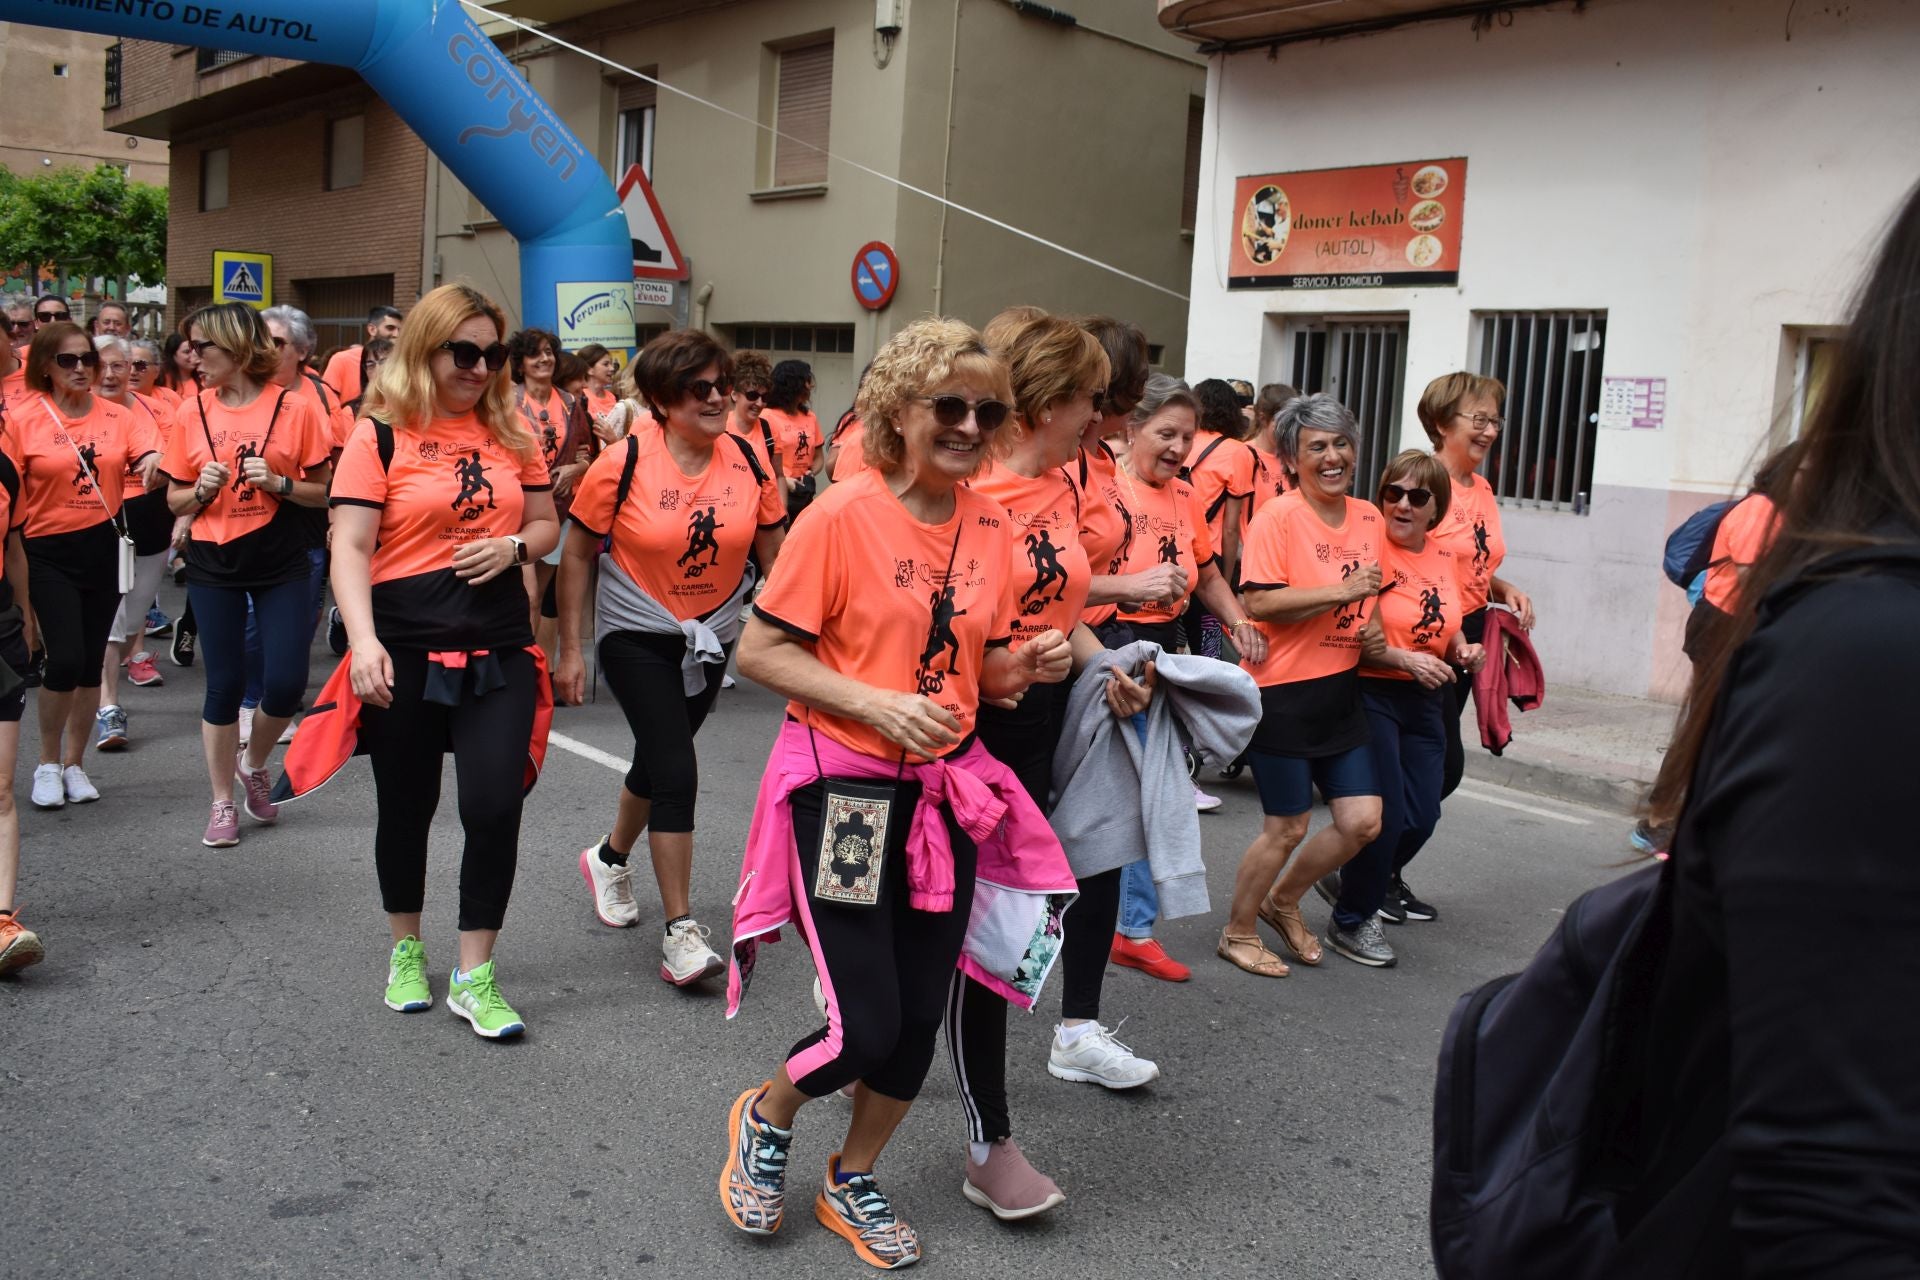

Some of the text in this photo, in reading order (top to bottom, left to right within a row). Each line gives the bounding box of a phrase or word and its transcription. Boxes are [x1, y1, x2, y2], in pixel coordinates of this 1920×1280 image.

[182, 5, 222, 28] DE
[226, 12, 318, 42] AUTOL
[1293, 207, 1405, 230] doner kebab
[1315, 239, 1376, 257] (AUTOL)
[1293, 275, 1383, 288] SERVICIO A DOMICILIO
[563, 292, 611, 331] Verona
[681, 582, 714, 590] CARRERA
